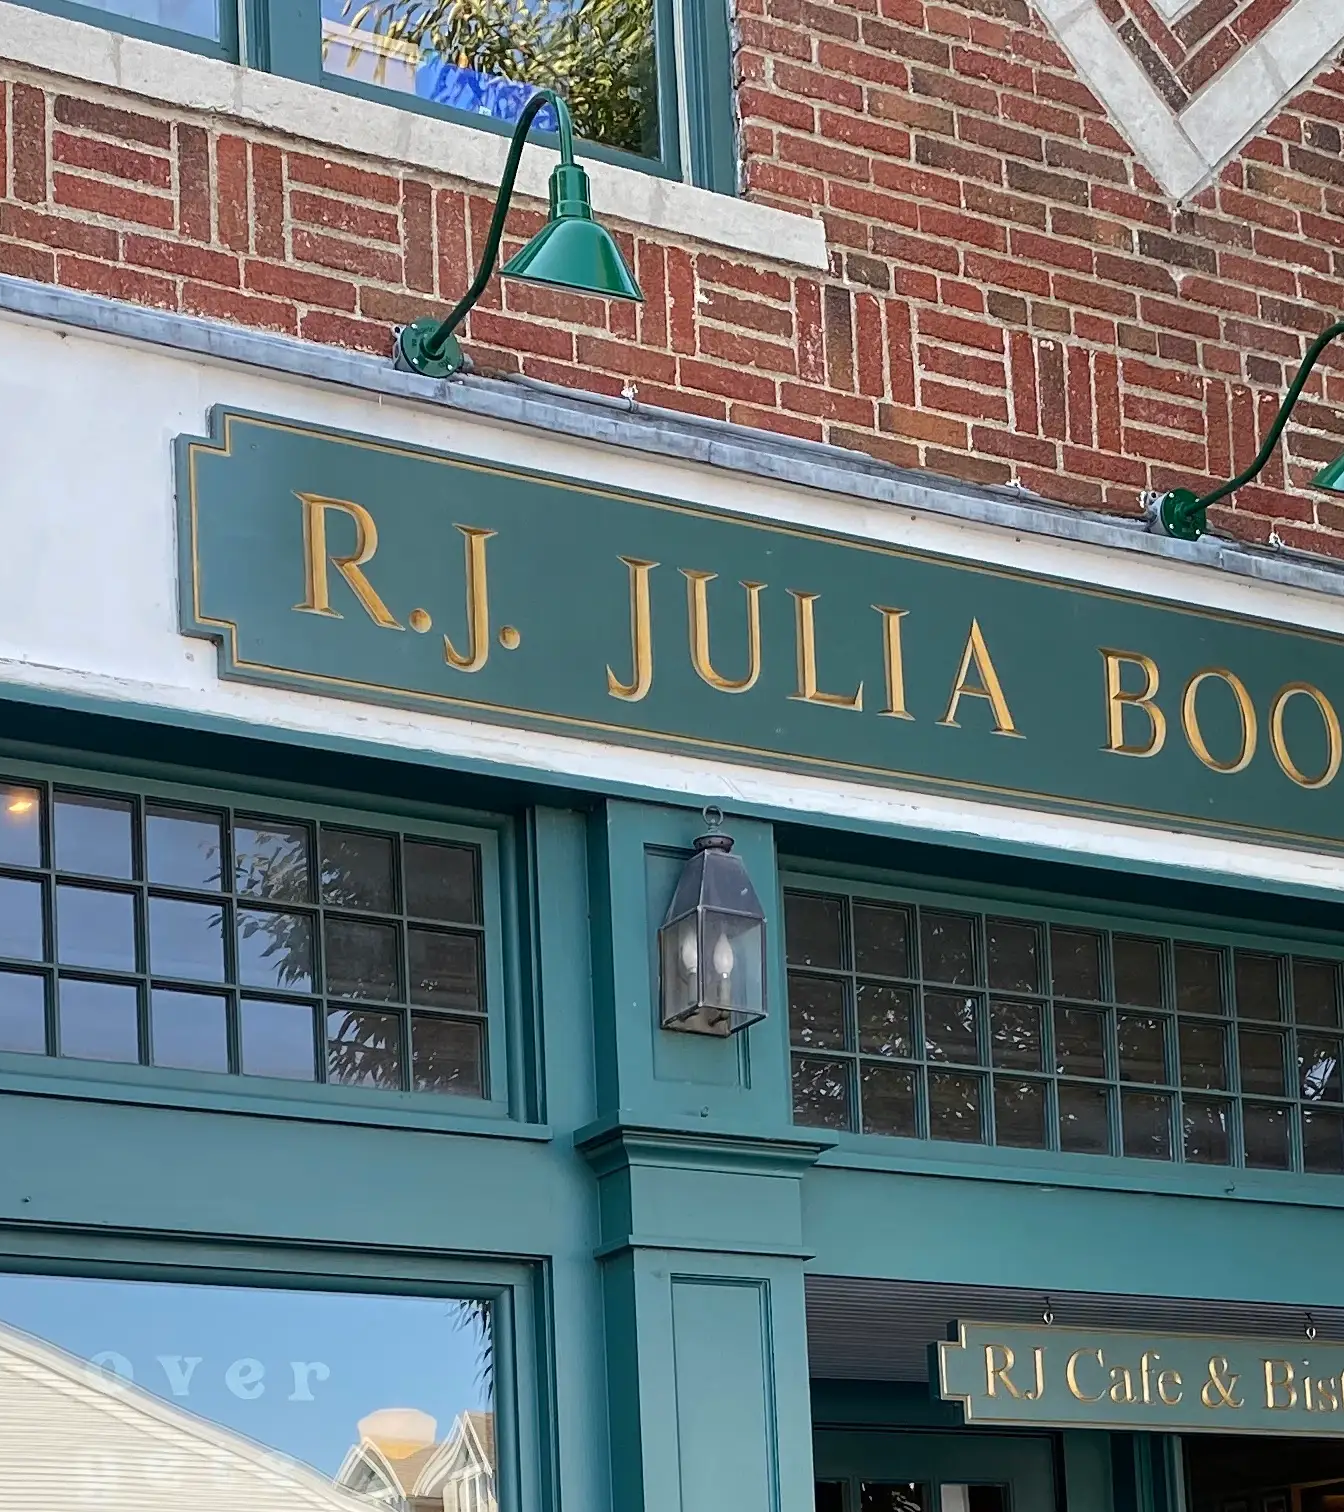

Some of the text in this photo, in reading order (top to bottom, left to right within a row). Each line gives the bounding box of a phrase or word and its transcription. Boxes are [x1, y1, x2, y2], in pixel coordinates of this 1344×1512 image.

[291, 489, 521, 673] R.J.
[607, 554, 1027, 739] JULIA
[90, 1349, 332, 1402] over
[981, 1343, 1047, 1400] RJ
[1066, 1348, 1184, 1407] Cafe
[1199, 1355, 1245, 1409] &
